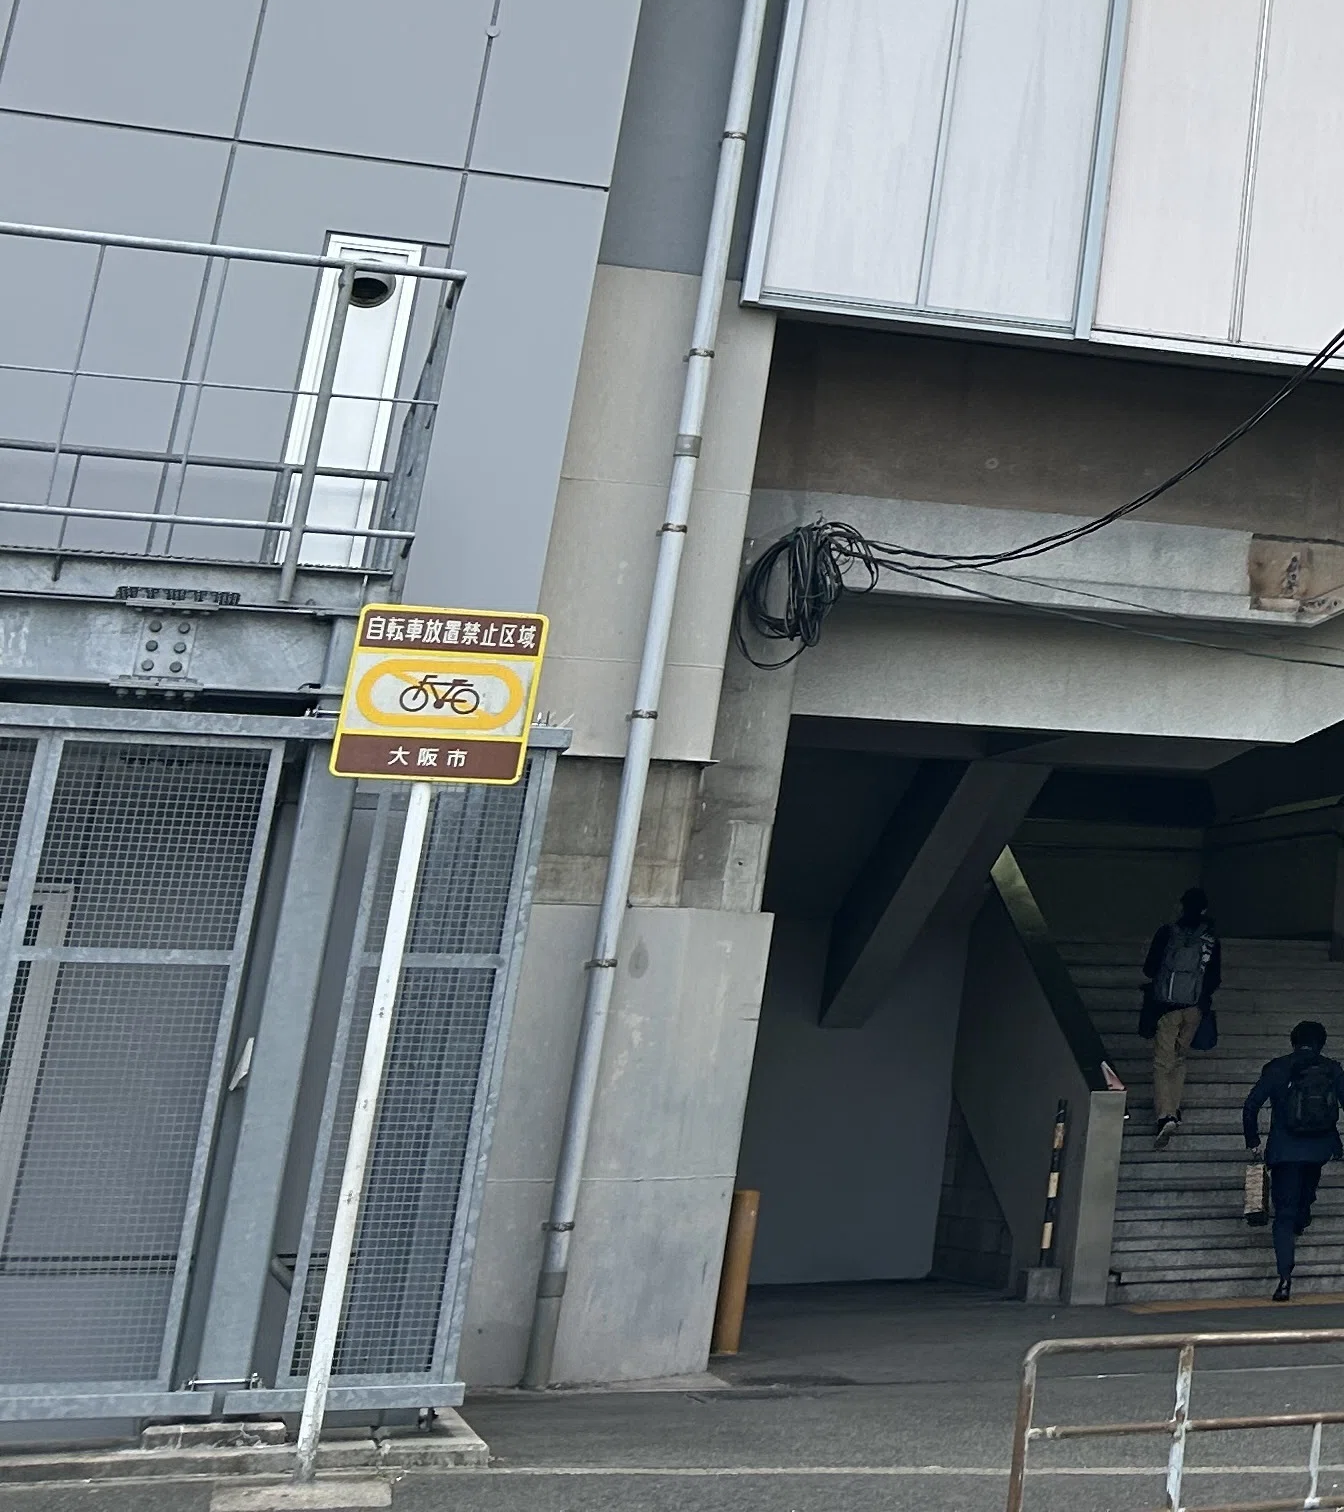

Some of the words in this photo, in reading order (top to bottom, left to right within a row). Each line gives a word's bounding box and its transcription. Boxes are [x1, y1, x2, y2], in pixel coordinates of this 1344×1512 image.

[366, 615, 537, 649] 自転車放置禁止区域
[387, 745, 468, 768] 大阪市
